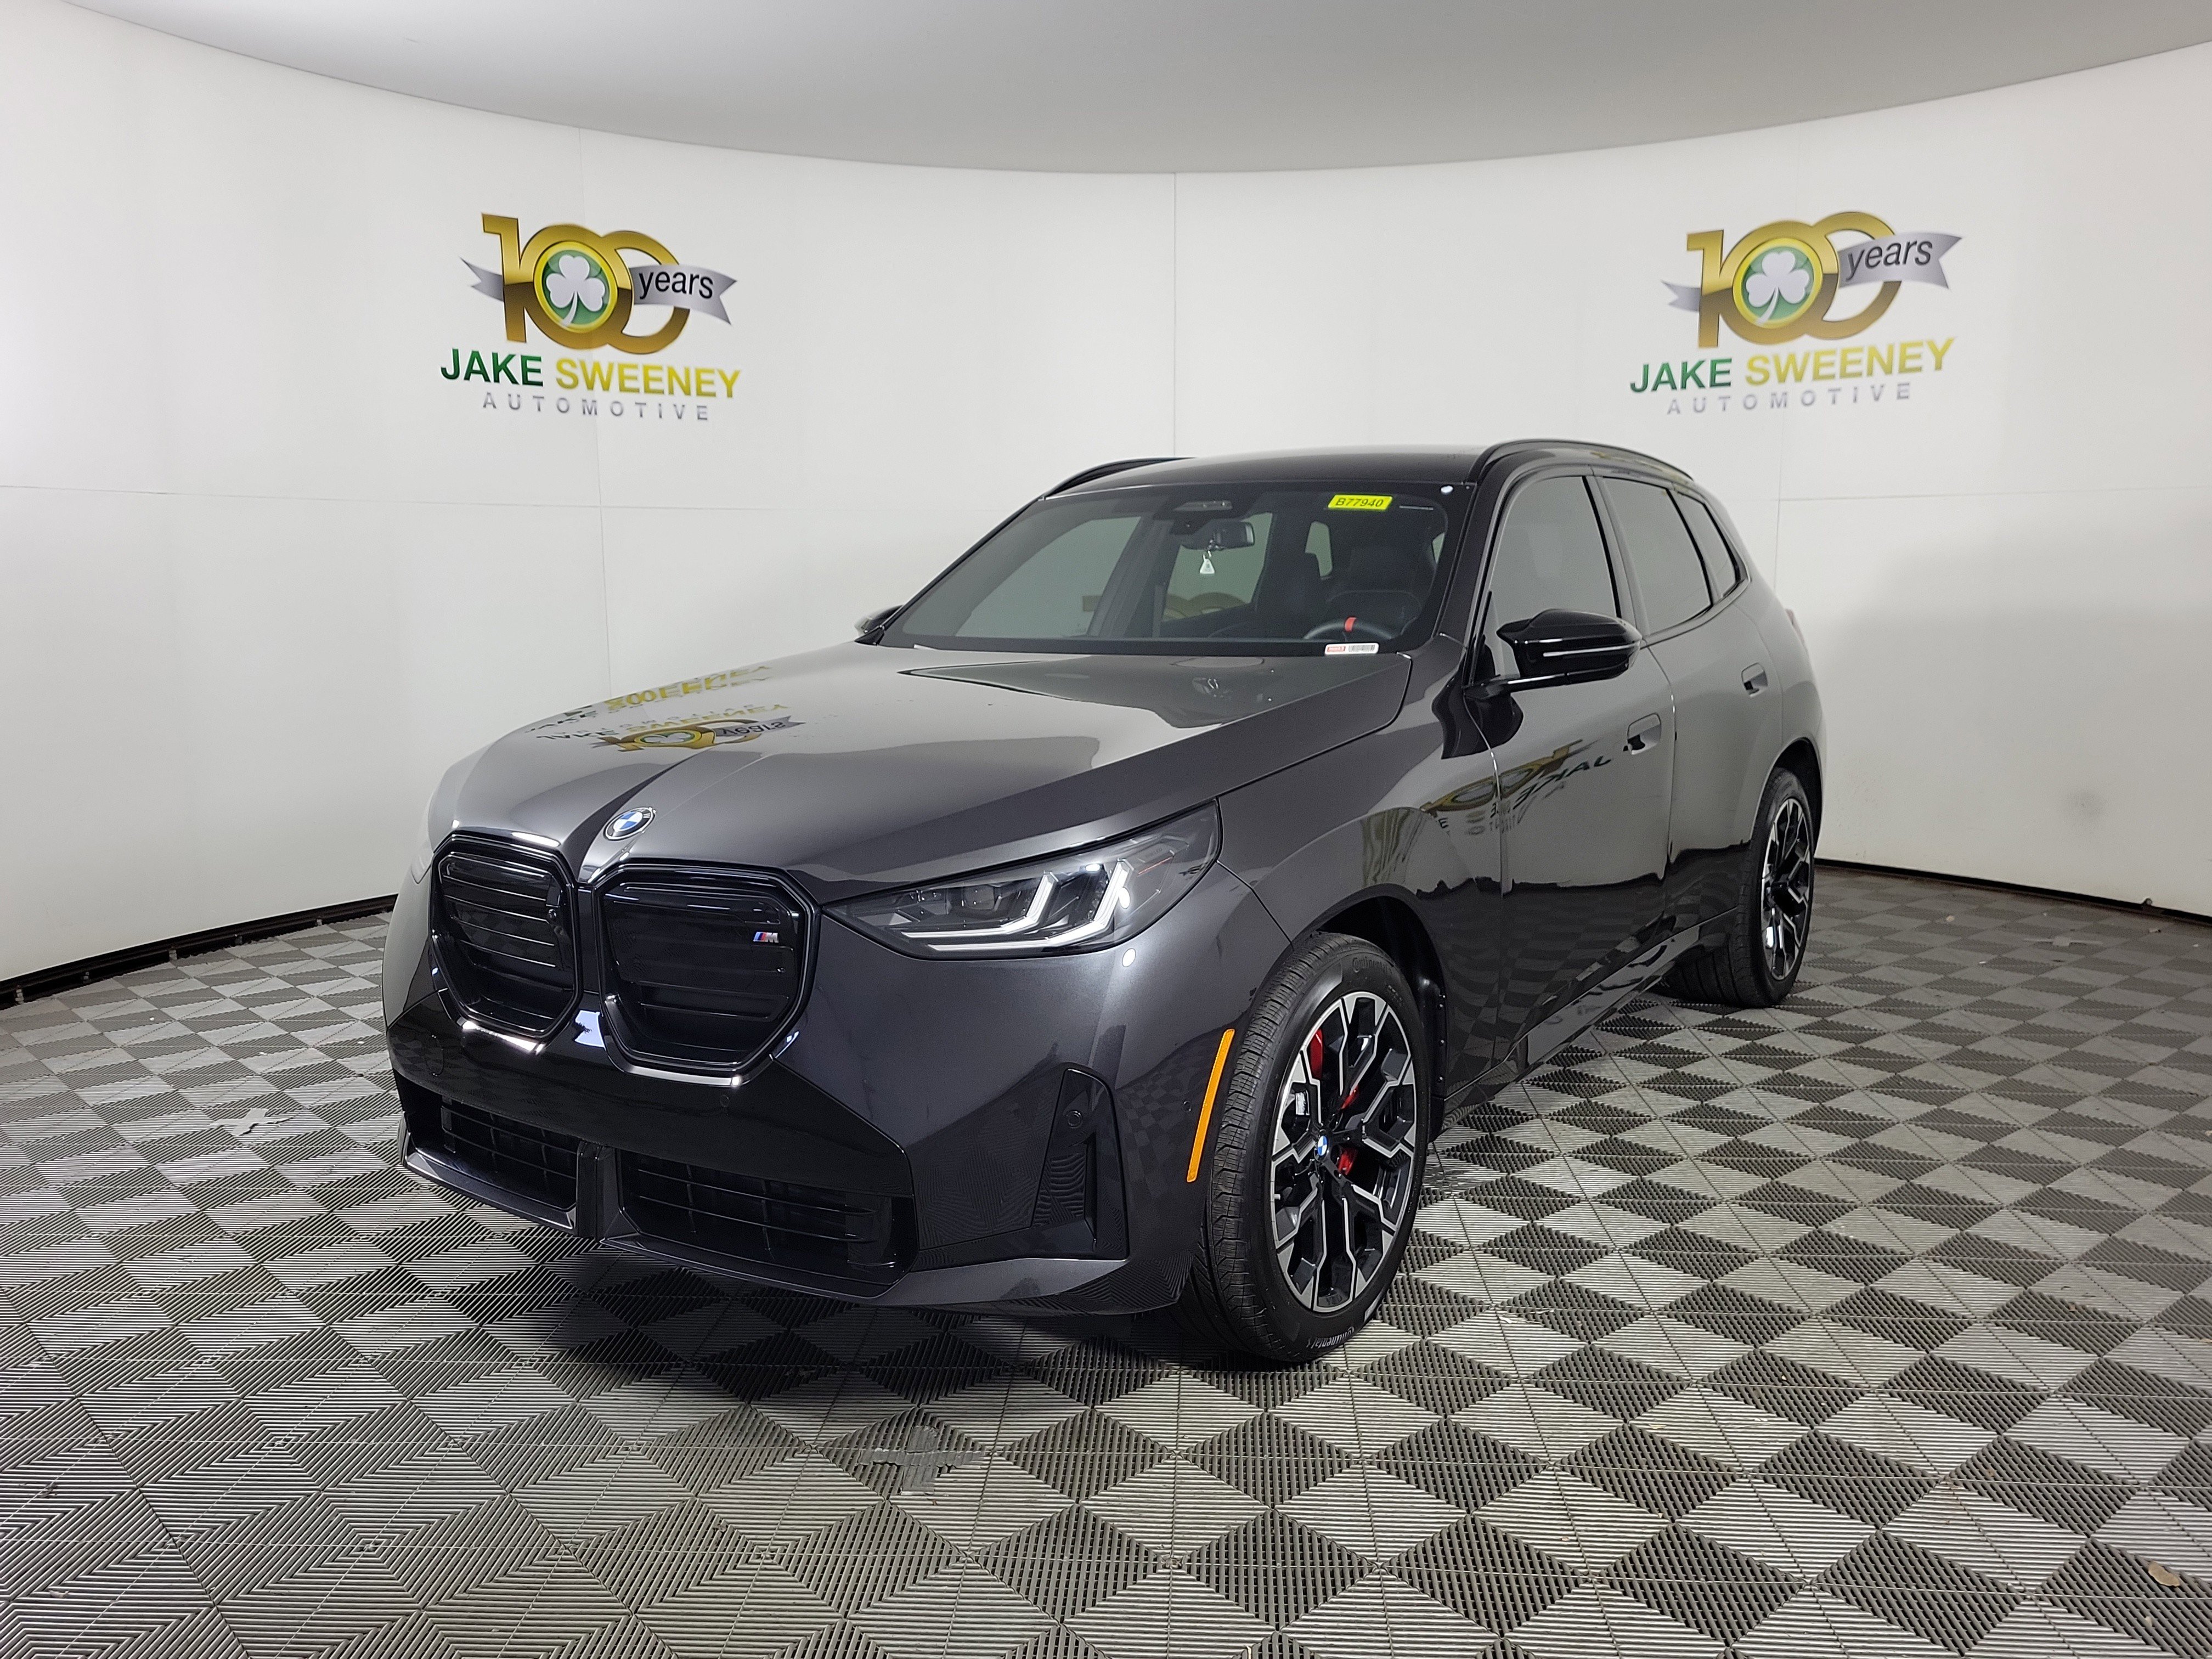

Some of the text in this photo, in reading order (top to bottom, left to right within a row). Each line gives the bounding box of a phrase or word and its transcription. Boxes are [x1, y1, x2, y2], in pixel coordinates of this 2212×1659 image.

[481, 213, 714, 354] 100 years
[1686, 211, 1933, 348] 100 years
[441, 348, 741, 399] JAKE SWEENEY
[1630, 336, 1957, 393] JAKE SWEENEY
[483, 392, 709, 421] AUTOMOTIVE
[1667, 382, 1910, 415] AUTOMOTIVE
[1335, 498, 1384, 507] B77940
[764, 932, 779, 943] M
